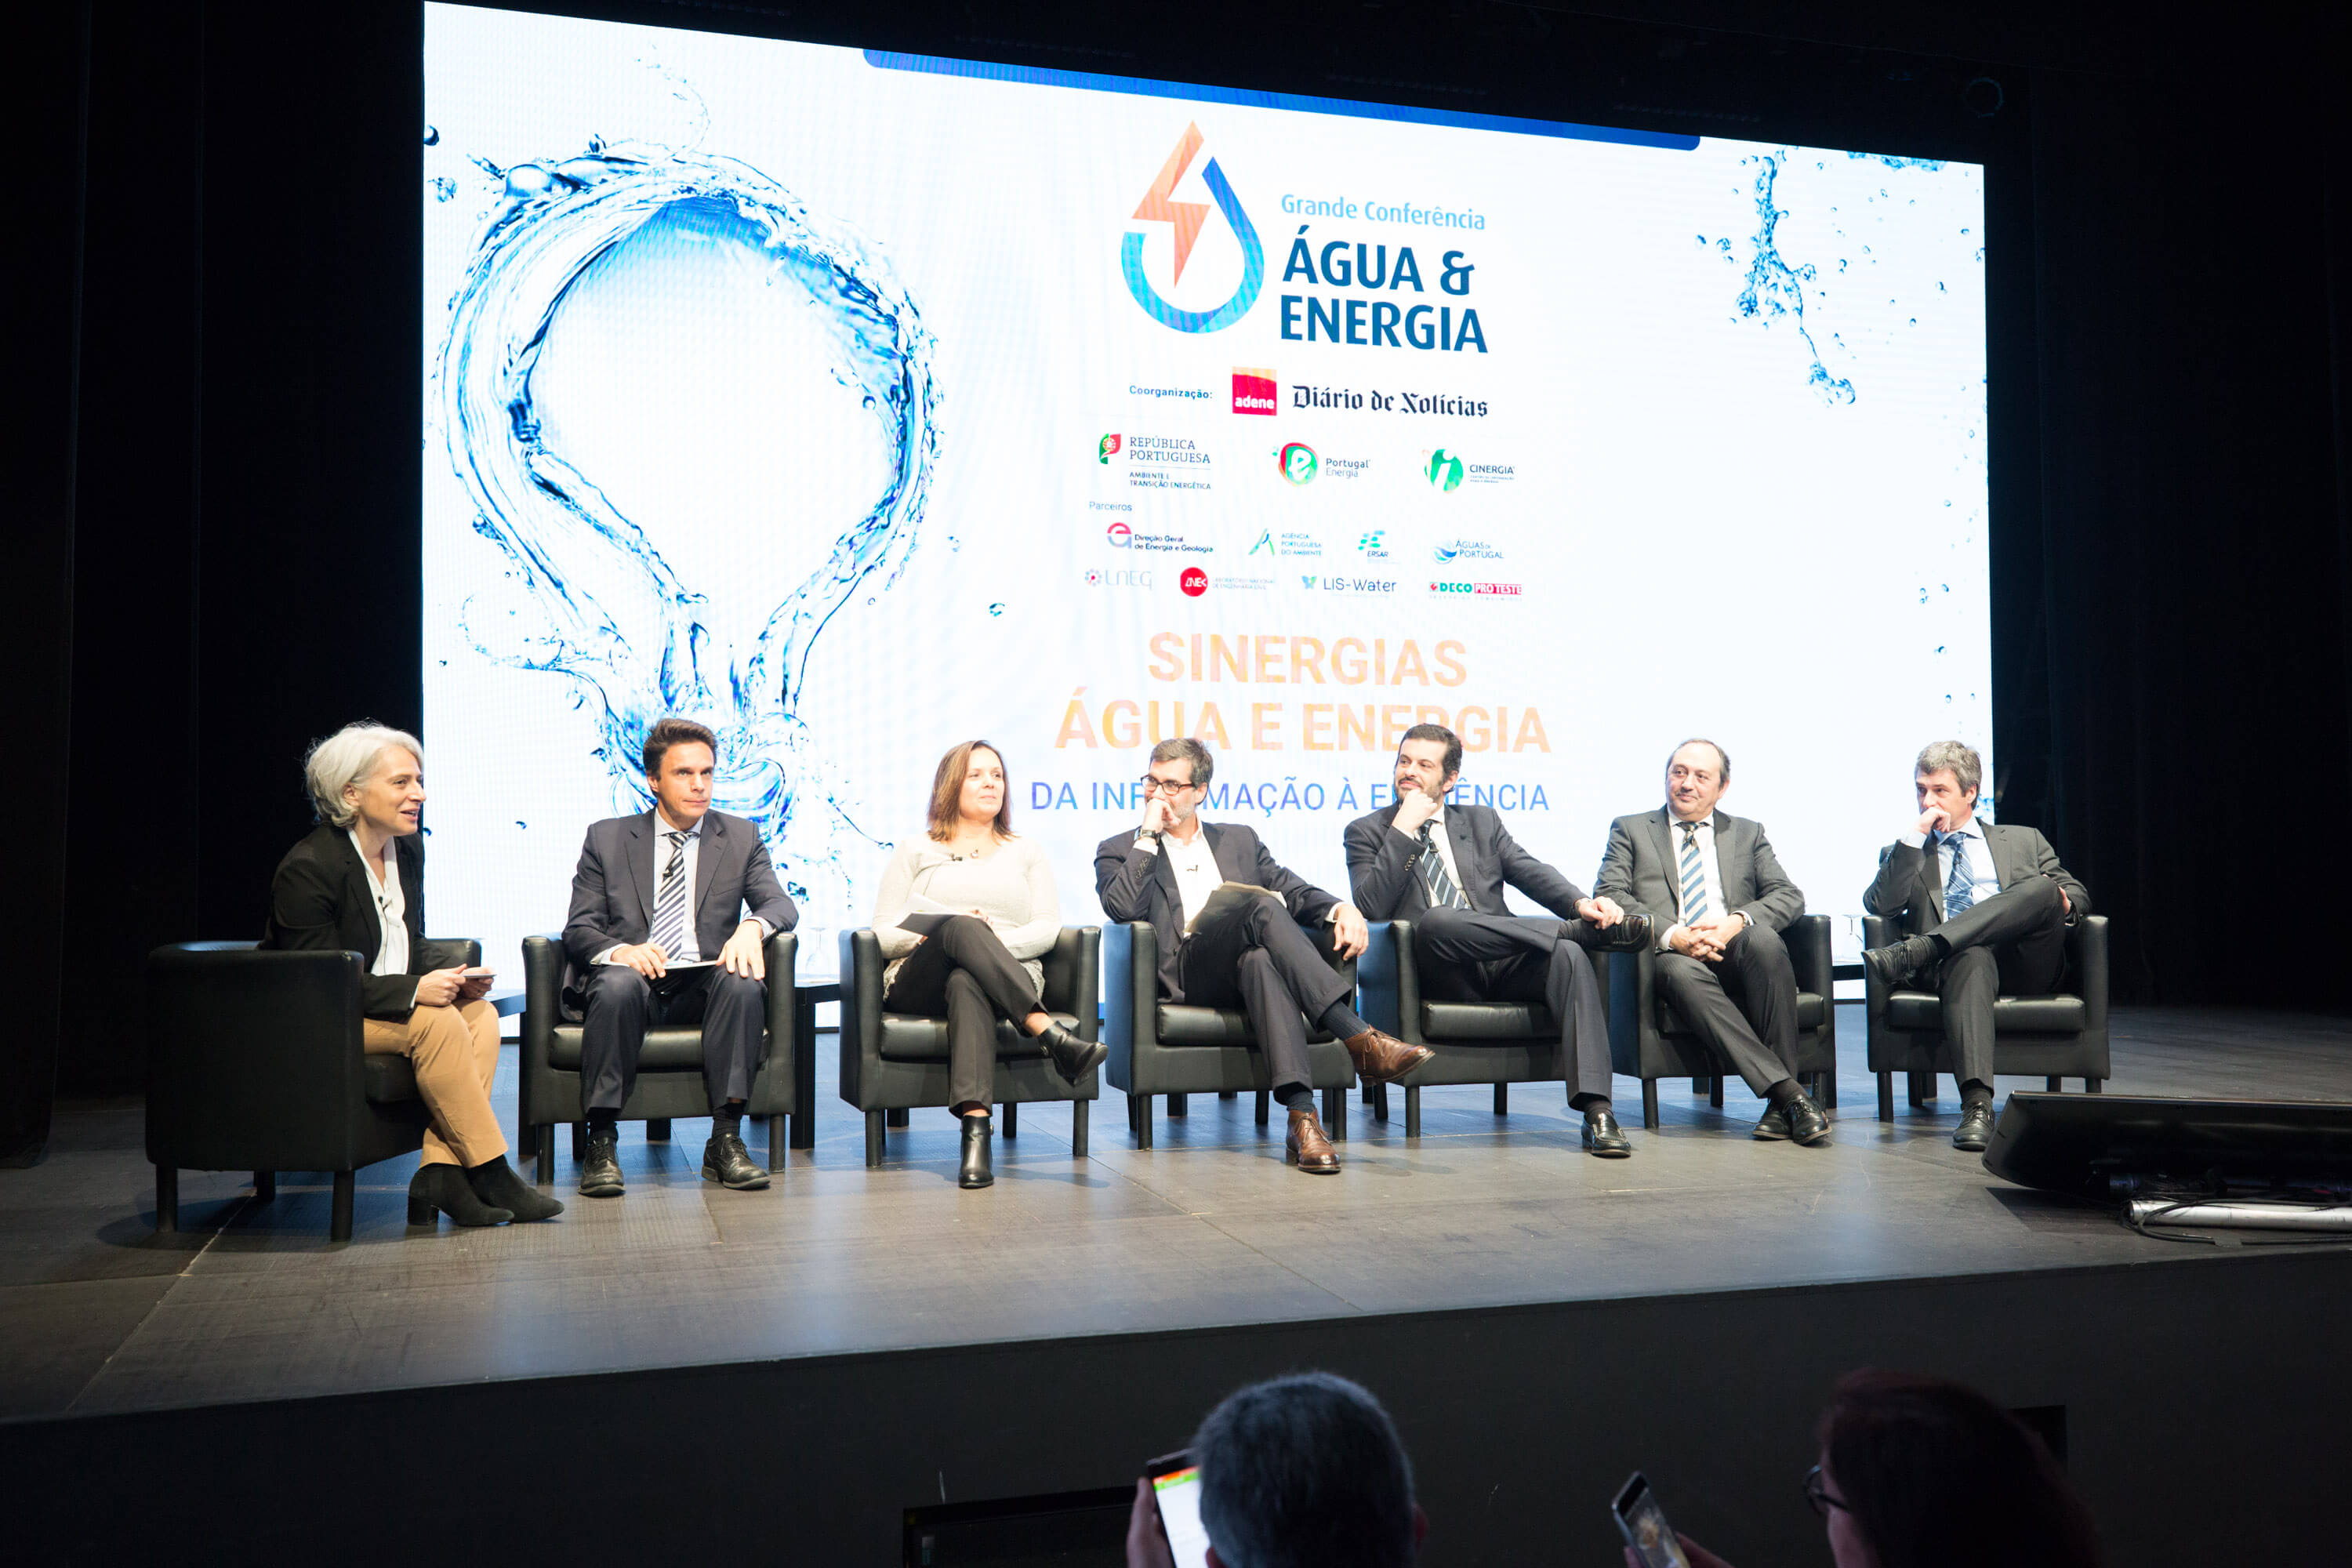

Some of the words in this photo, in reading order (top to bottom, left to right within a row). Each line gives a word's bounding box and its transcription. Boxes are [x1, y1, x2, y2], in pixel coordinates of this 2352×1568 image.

[1281, 194, 1358, 219] Grande
[1365, 201, 1486, 230] Conferência
[1282, 224, 1425, 292] ÁGUA
[1439, 250, 1475, 296] &
[1280, 294, 1488, 354] ENERGIA
[1129, 385, 1213, 401] Coorganização:
[1235, 396, 1275, 409] adene
[1292, 385, 1363, 410] Diário
[1370, 390, 1395, 412] de
[1399, 392, 1488, 417] Notícias
[1129, 435, 1196, 450] REPÚBLICA
[1129, 449, 1210, 464] PORTUGUESA
[1326, 458, 1369, 470] Portugal
[1326, 467, 1359, 479] Energia
[1469, 464, 1514, 474] CINERGIA
[1089, 501, 1133, 511] Parceiros
[1145, 543, 1173, 552] Energia
[1181, 544, 1214, 554] Geologia
[1459, 549, 1504, 558] PORTUGAL
[1323, 577, 1397, 592] LIS-Water
[1439, 583, 1473, 593] DECO
[1148, 631, 1467, 688] SINERGIAS
[1054, 686, 1232, 750] ÁGUA
[1251, 702, 1283, 750] E
[1030, 781, 1079, 810] DA
[1092, 775, 1325, 818] INFMAÇÃO
[1337, 775, 1359, 811] À
[1370, 777, 1550, 811] EÊNCIA
